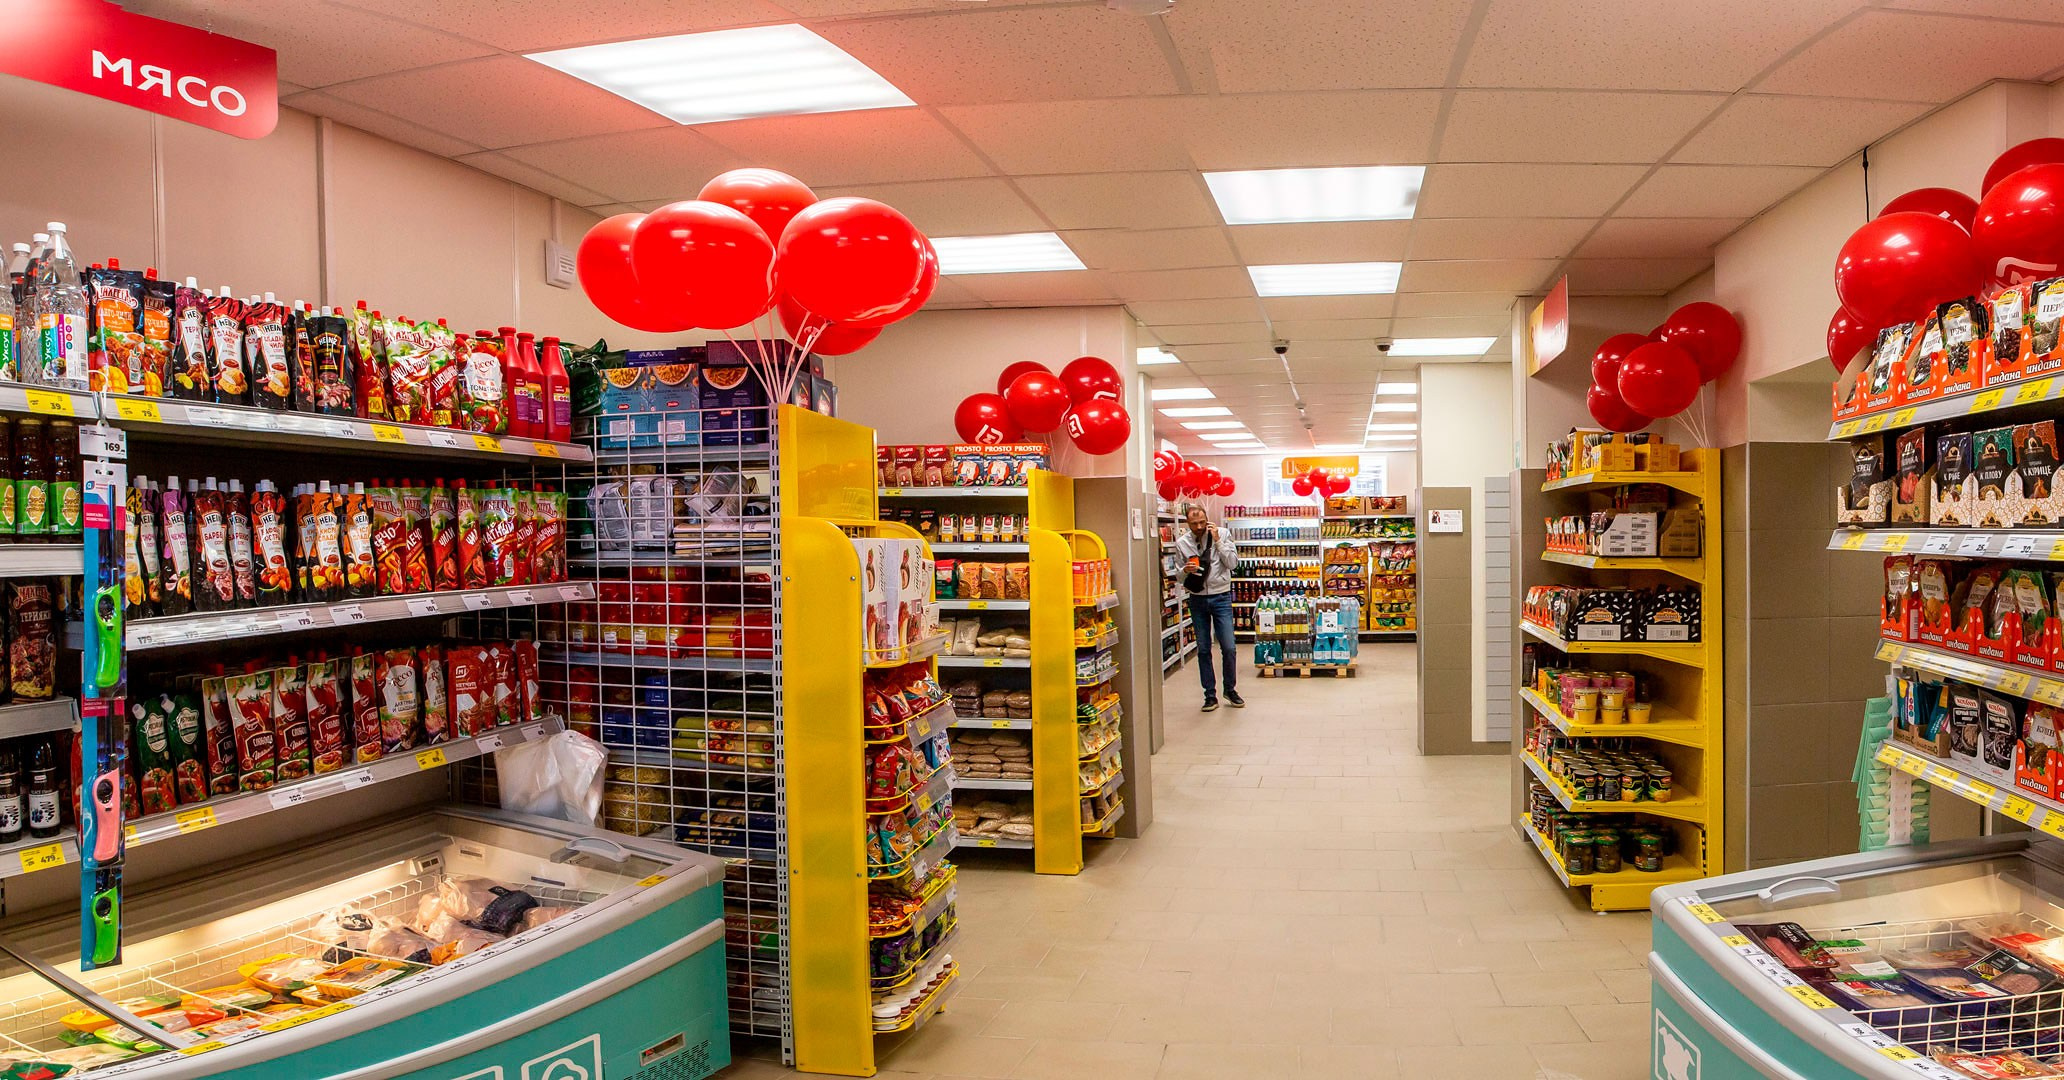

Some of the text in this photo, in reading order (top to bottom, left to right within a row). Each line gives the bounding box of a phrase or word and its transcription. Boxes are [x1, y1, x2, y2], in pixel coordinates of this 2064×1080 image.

[92, 50, 247, 117] МЯСО
[264, 324, 281, 333] HEIN
[2026, 358, 2062, 374] индана
[1988, 370, 2021, 385] индана
[1944, 381, 1971, 394] индана
[104, 442, 120, 451] 169
[1984, 470, 2002, 479] ПЛОВУ
[2028, 466, 2052, 476] КУРИЦЕ
[350, 612, 363, 620] 179
[297, 618, 311, 626] 179
[1921, 632, 1943, 643] индана
[1946, 639, 1969, 651] индана
[1979, 645, 2004, 658] индана
[2017, 653, 2044, 667] индана
[360, 775, 371, 783] 109
[2020, 777, 2048, 793] индана
[40, 854, 56, 863] 479
